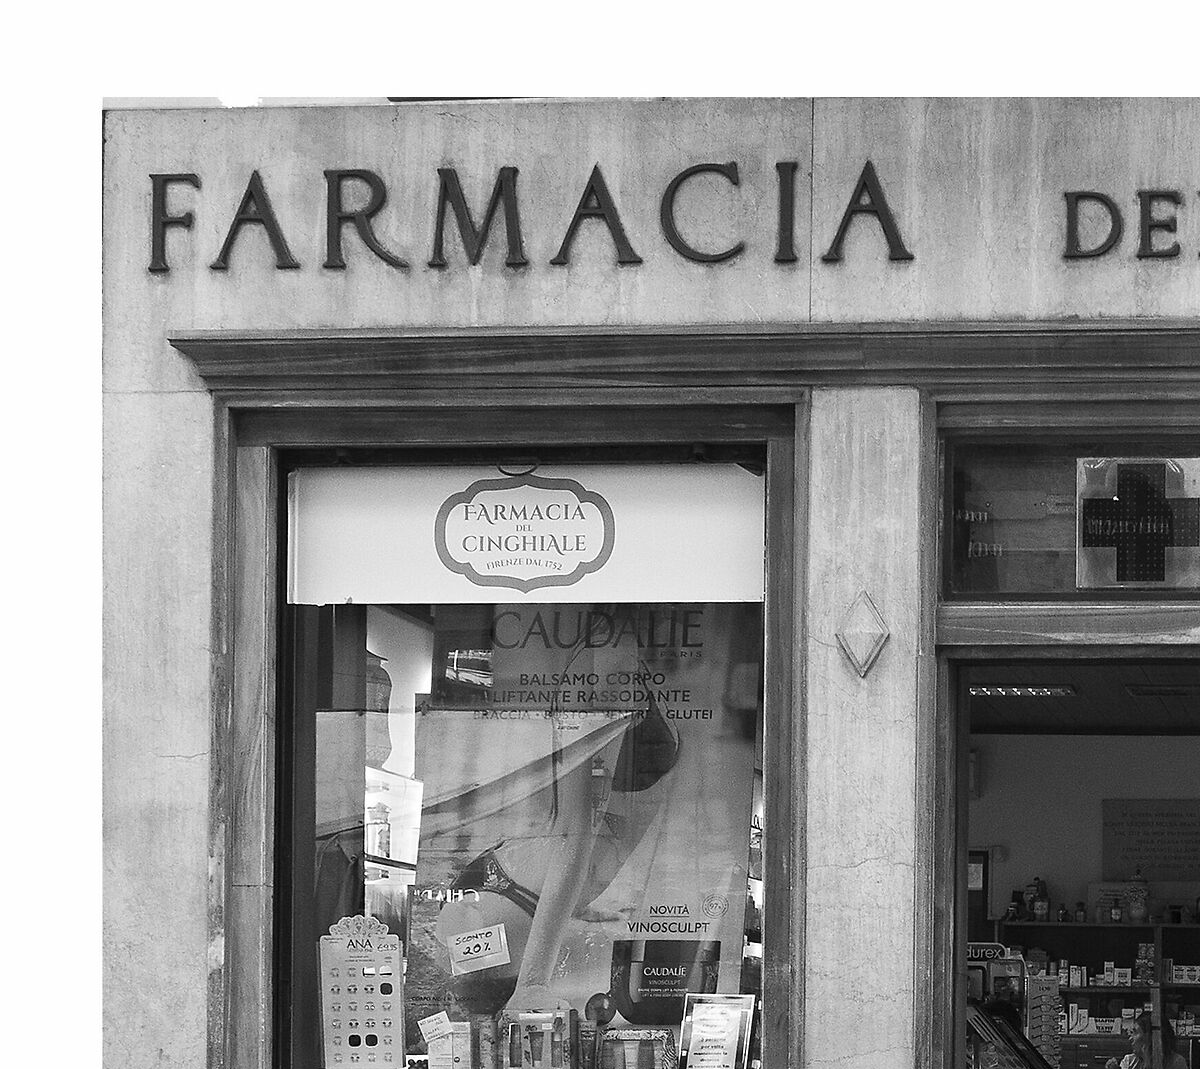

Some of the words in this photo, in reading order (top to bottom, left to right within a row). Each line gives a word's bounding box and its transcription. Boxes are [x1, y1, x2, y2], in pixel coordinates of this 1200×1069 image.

[147, 160, 914, 273] FARMACIA
[463, 503, 586, 525] FARMACIA
[515, 524, 533, 532] DEL
[462, 533, 586, 556] CINGHIALE
[486, 557, 524, 571] FIRENZE
[525, 558, 543, 567] DAL
[545, 560, 563, 571] 1752
[519, 673, 600, 686] BALSAMO
[605, 673, 666, 686] CORPO
[492, 690, 572, 703] LIFTANTE
[577, 690, 691, 702] RASSODANTE
[473, 710, 531, 720] BRACCIA
[665, 709, 713, 720] GLUTEI
[650, 904, 690, 915] NOVITÀ
[627, 922, 710, 933] VINOSCULPT
[346, 939, 373, 949] ANA
[455, 930, 493, 945] SCONTO
[462, 943, 491, 956] 20%
[967, 945, 1001, 958] durex
